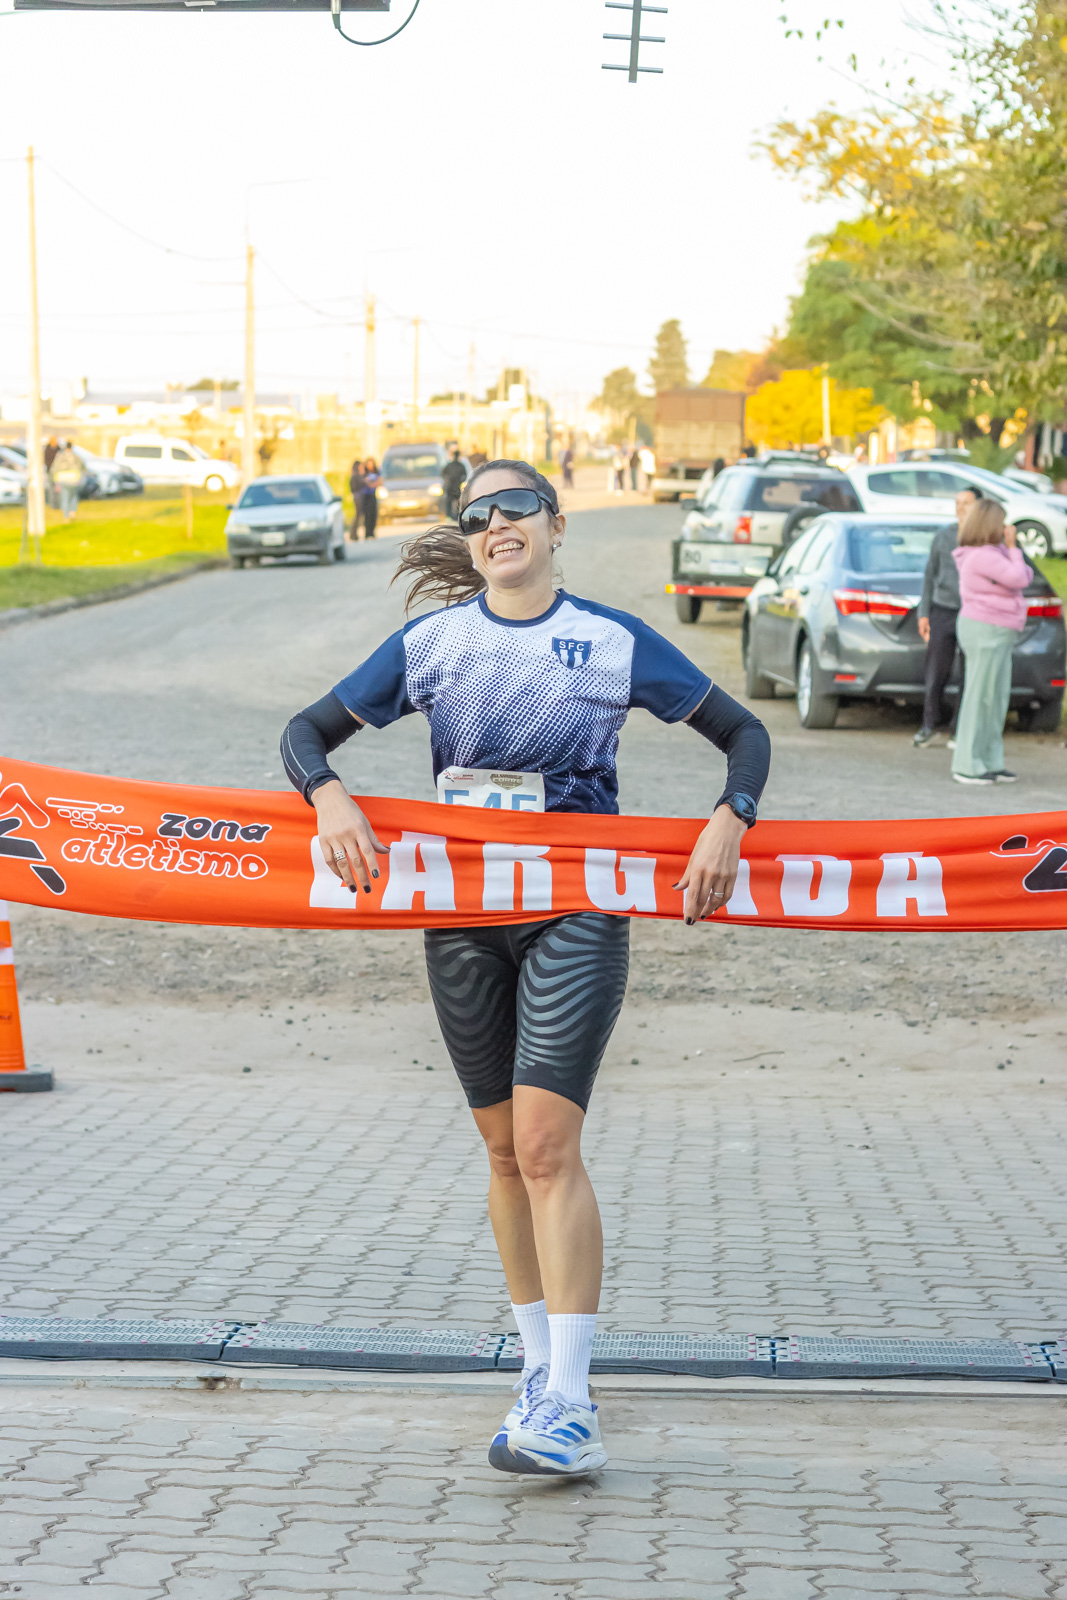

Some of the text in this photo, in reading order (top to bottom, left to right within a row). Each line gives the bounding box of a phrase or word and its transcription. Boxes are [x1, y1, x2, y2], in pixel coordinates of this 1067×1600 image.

[559, 640, 585, 652] SFC
[157, 813, 272, 843] zona
[61, 833, 269, 880] atletismo
